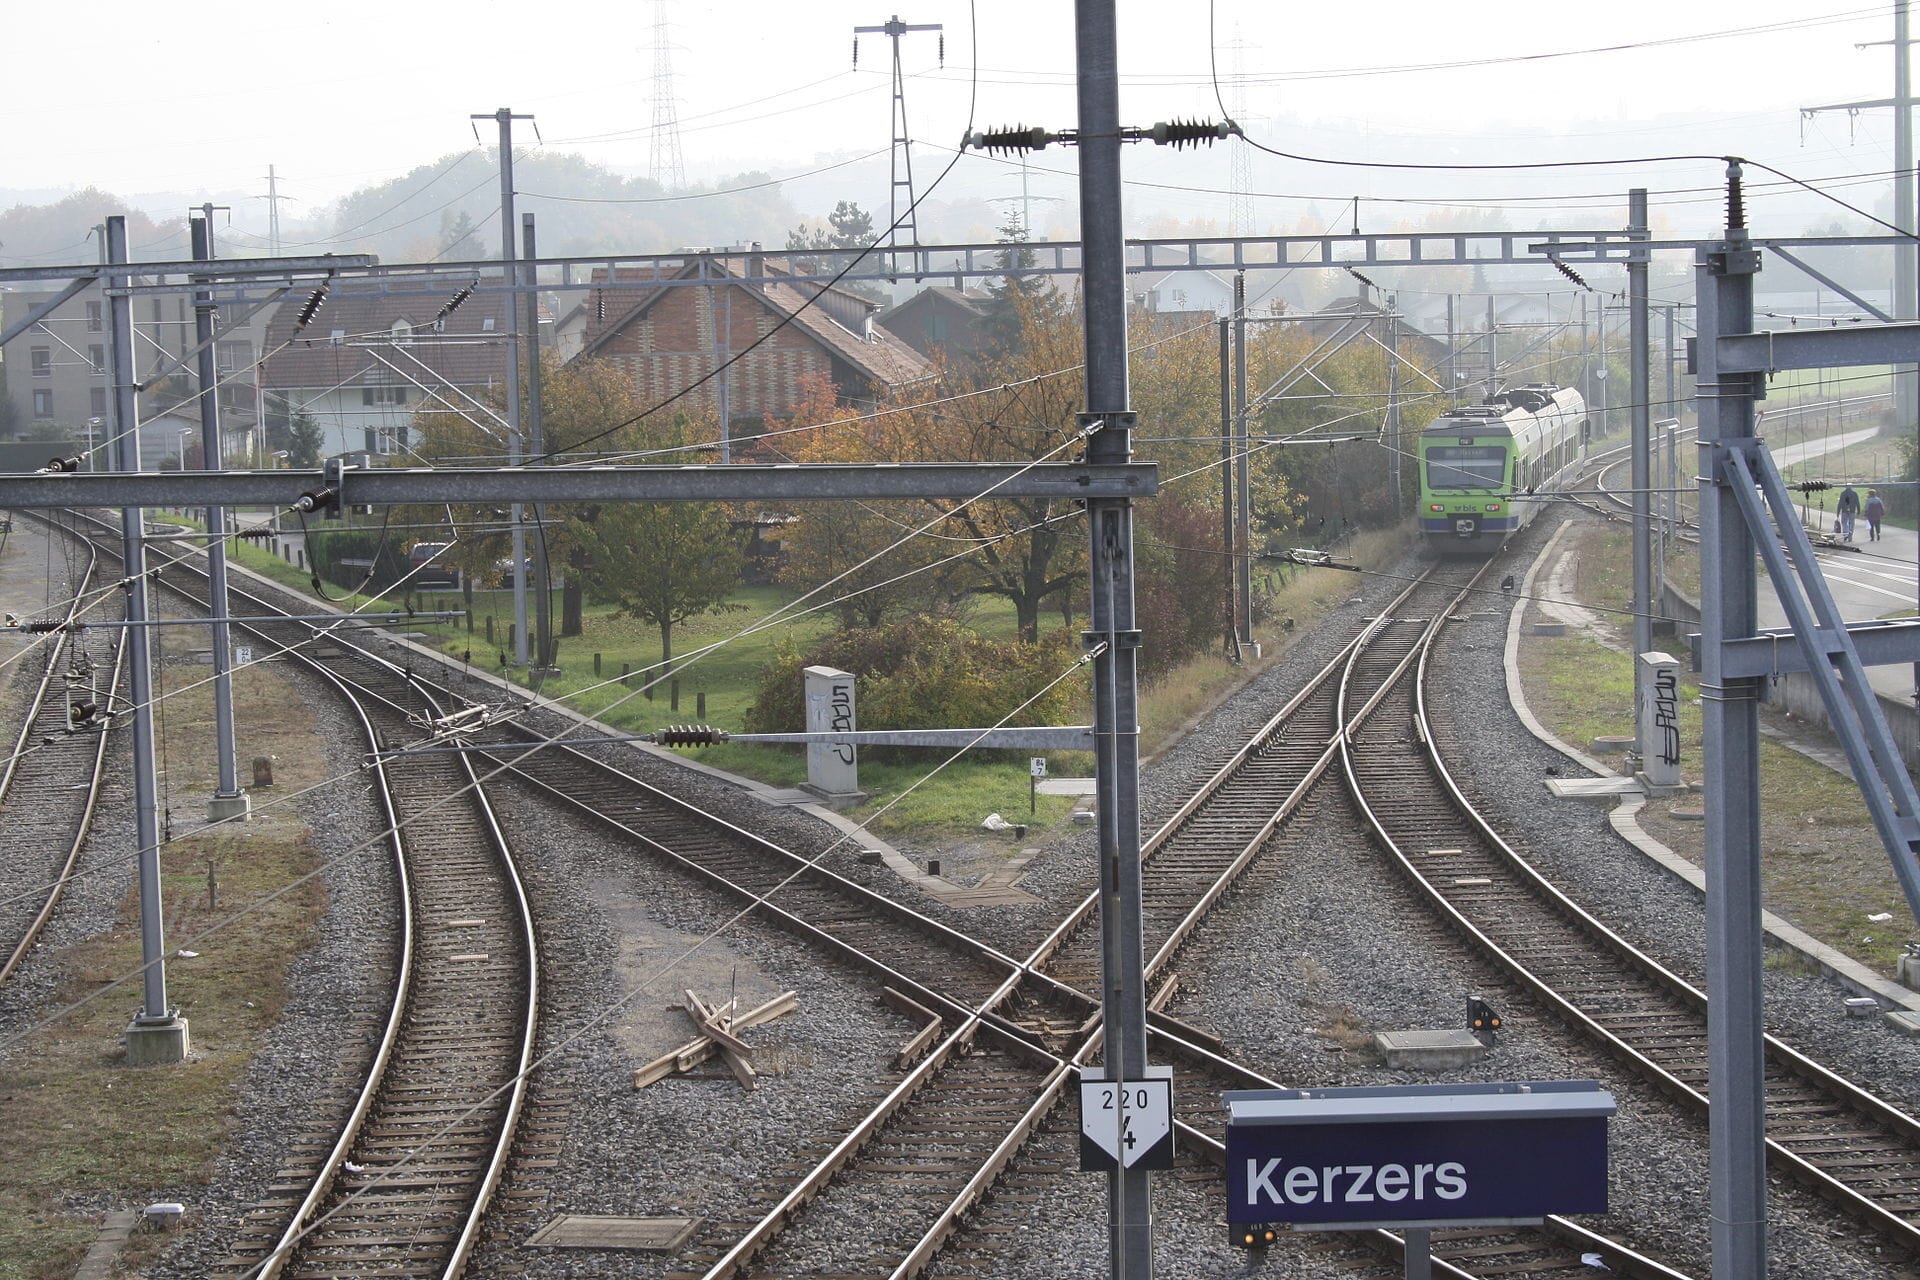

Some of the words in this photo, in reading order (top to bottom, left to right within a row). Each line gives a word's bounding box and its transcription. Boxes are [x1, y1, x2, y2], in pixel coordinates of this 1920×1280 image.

[1463, 504, 1477, 512] bls
[1102, 1089, 1148, 1110] 220
[1119, 1115, 1137, 1150] 4
[1247, 1157, 1468, 1205] Kerzers
